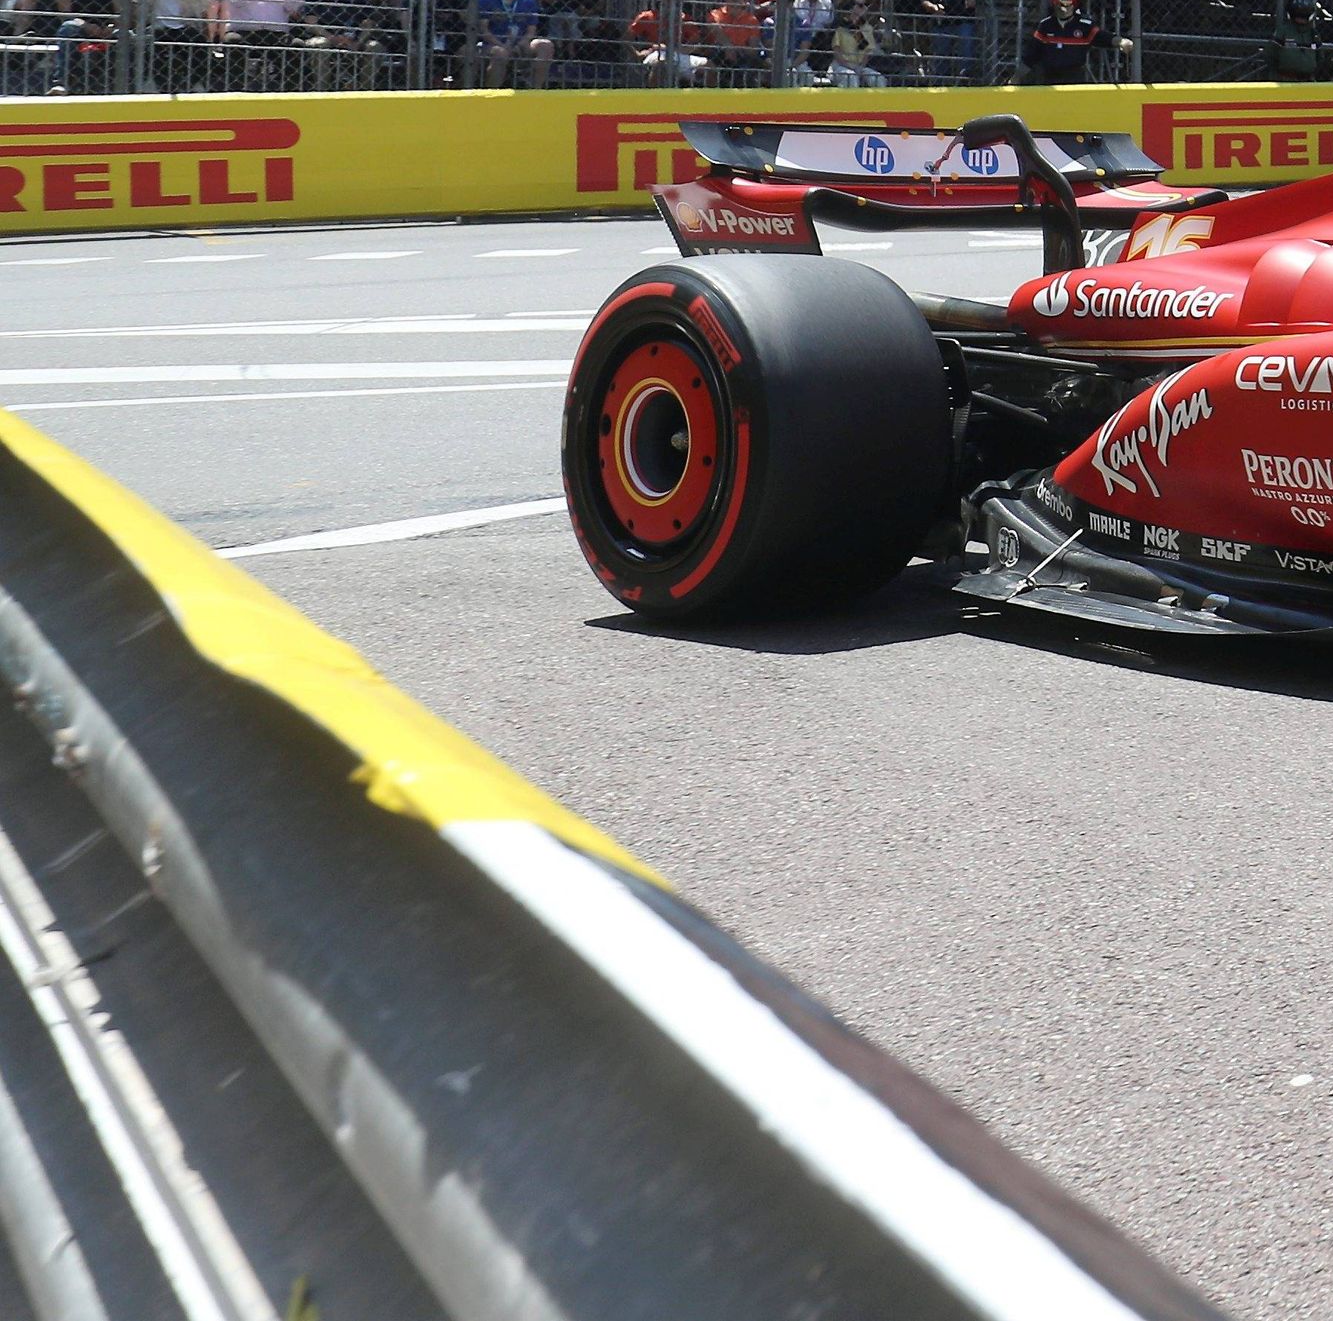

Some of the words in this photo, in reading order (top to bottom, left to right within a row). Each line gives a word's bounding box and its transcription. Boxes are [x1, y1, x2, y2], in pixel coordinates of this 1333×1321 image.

[860, 135, 890, 175] hp
[698, 208, 795, 236] V-Power
[1074, 279, 1234, 318] Santander
[1036, 478, 1073, 522] brembo
[1252, 487, 1293, 502] NASTRO
[1089, 512, 1131, 541] MAHLE
[1143, 525, 1180, 552] NGK
[1201, 537, 1252, 562] SKF
